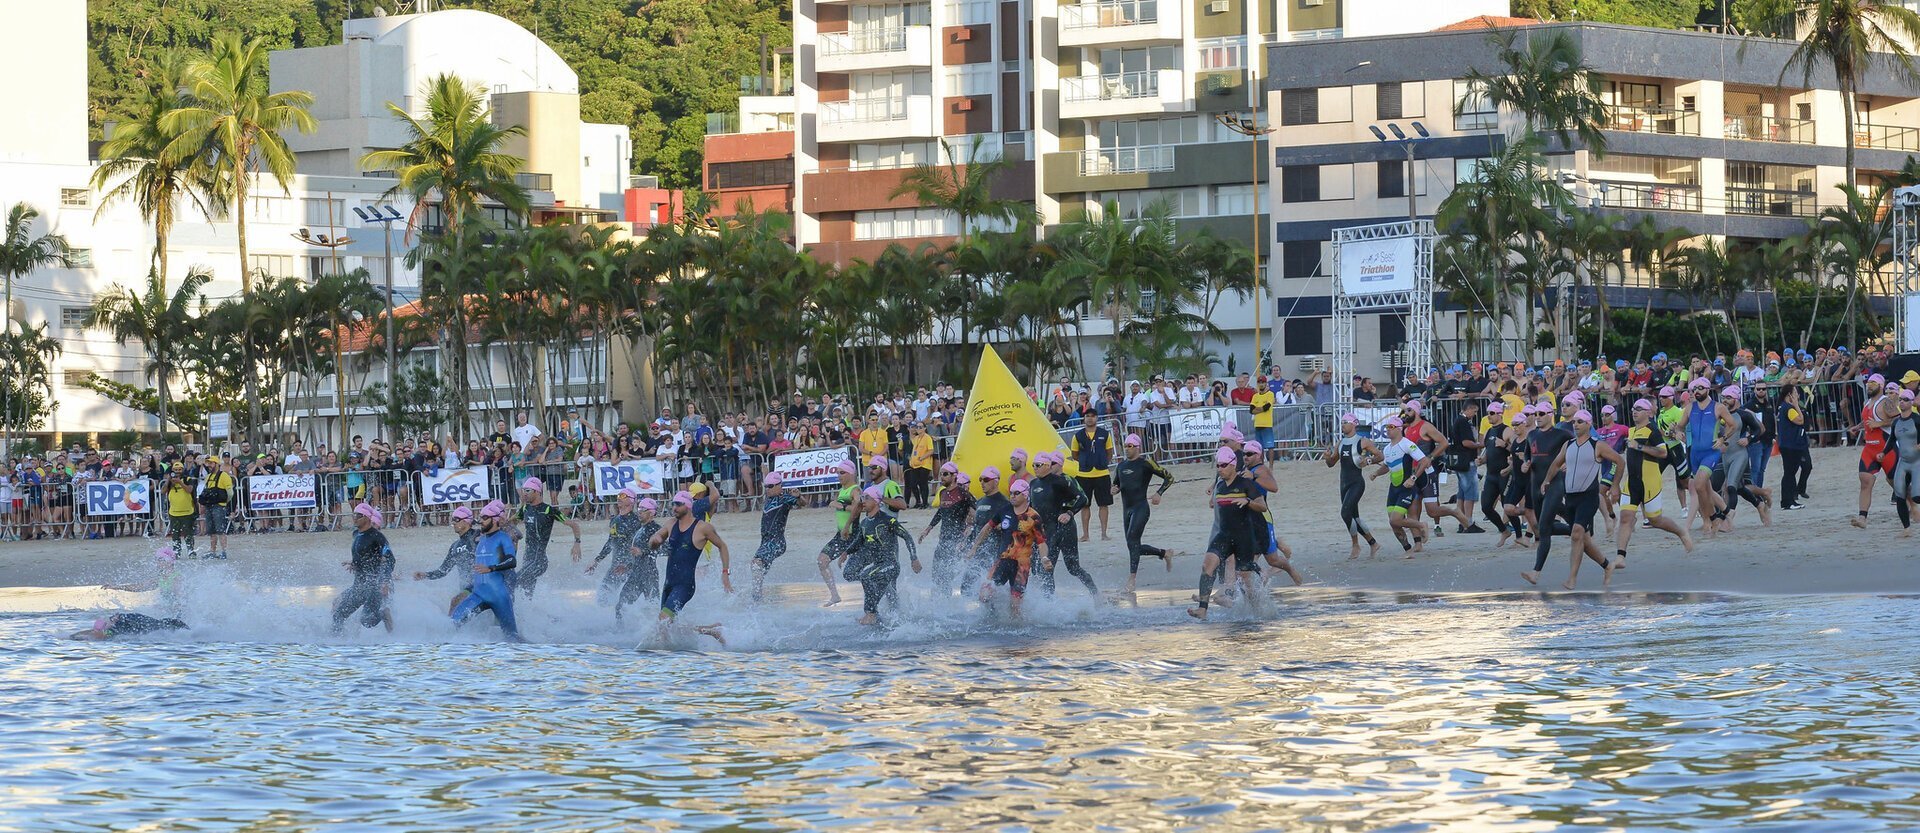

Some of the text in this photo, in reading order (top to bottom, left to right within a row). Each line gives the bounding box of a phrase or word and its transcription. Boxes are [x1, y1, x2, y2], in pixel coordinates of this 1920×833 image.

[1360, 265, 1395, 275] Triathlon
[816, 451, 849, 465] Sesc
[600, 462, 656, 491] RPC
[779, 464, 840, 479] riathlo
[286, 475, 314, 489] Sesc
[88, 481, 147, 512] RPC
[250, 489, 315, 501] Triathlon
